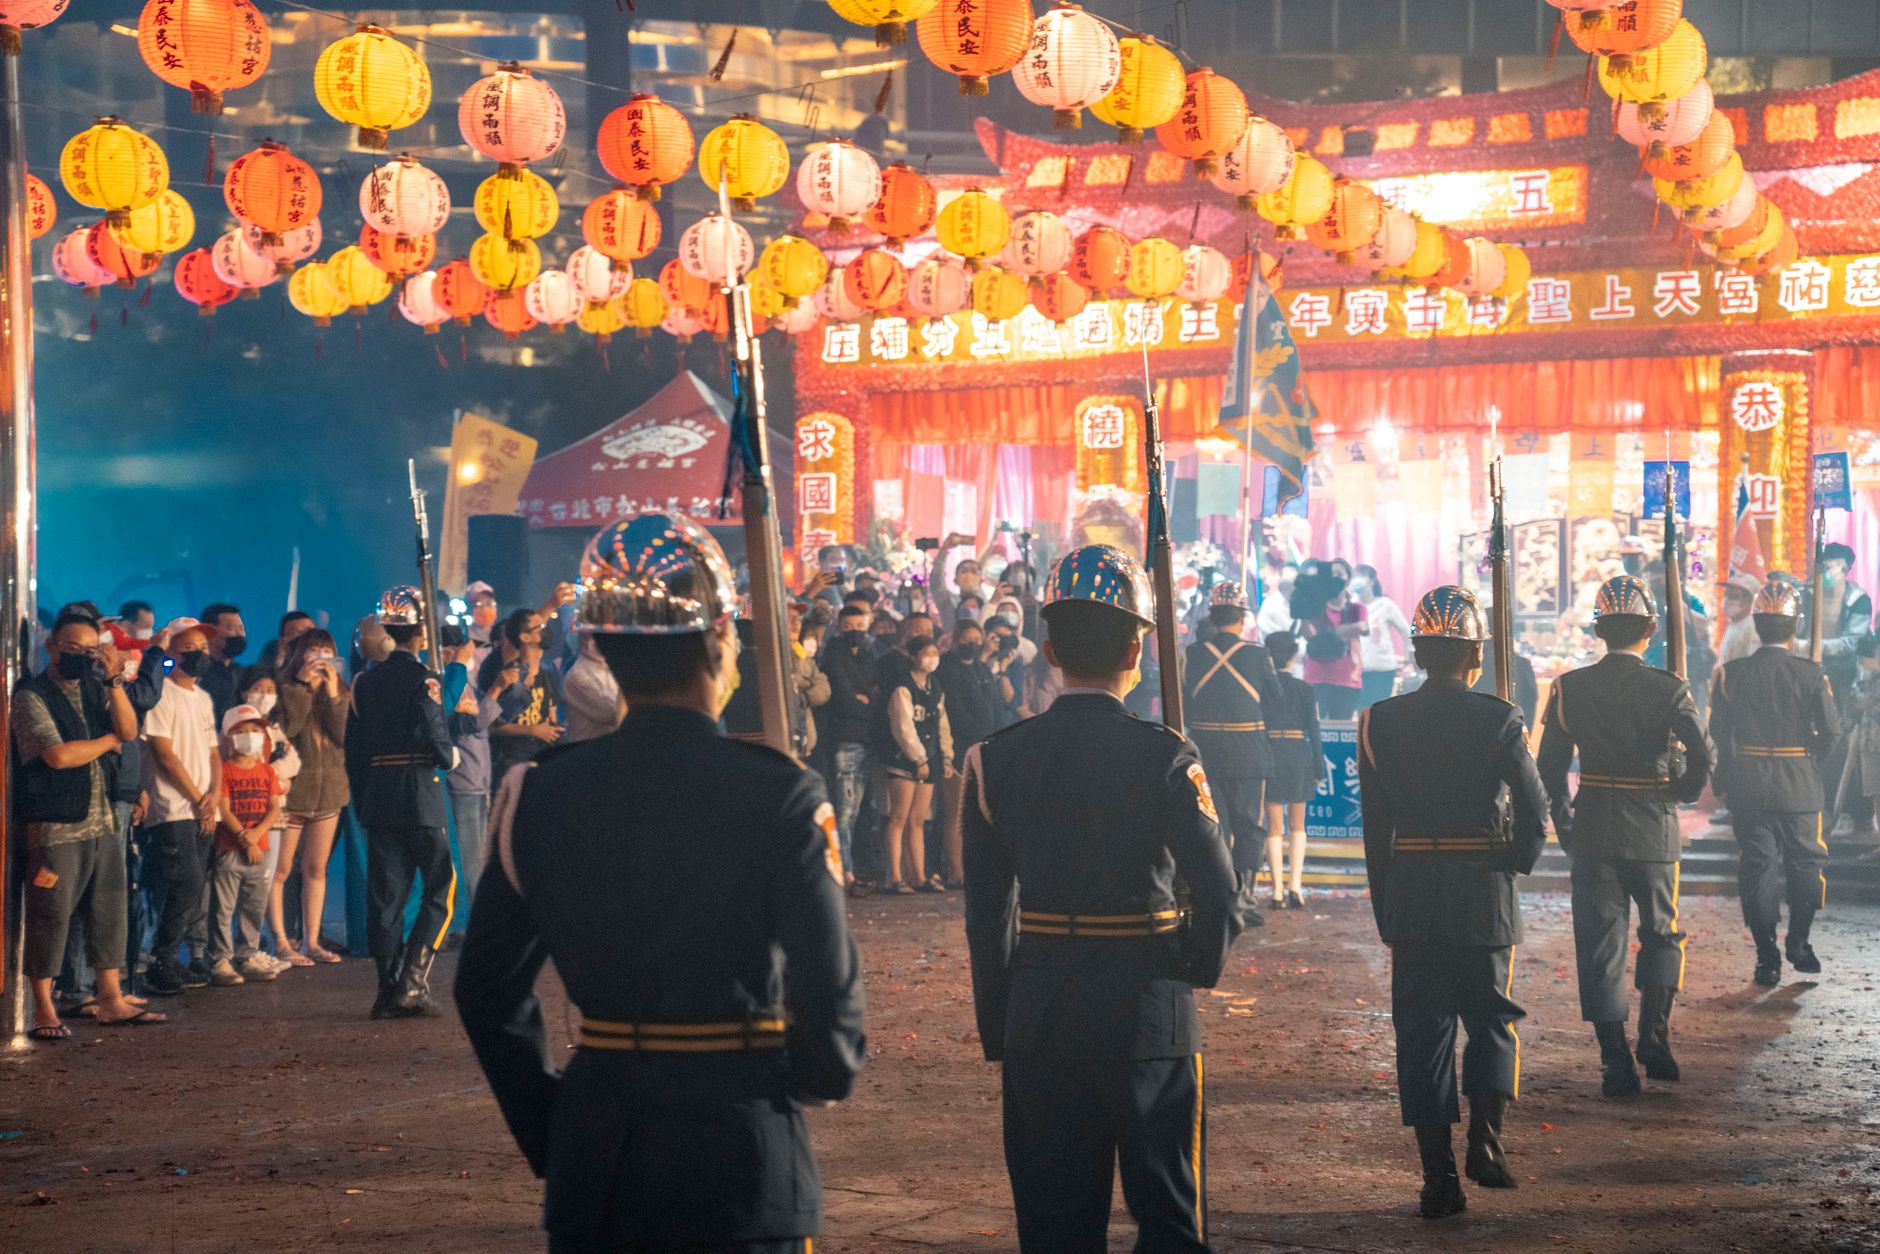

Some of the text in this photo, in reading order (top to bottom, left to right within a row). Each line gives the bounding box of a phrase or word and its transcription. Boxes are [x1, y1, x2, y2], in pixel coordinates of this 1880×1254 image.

[241, 11, 264, 76] 慈祐宮
[954, 0, 981, 56] 泰民安
[1031, 17, 1056, 89] 風調雨順
[335, 41, 361, 111] 風調雨順
[481, 79, 504, 146] 風調雨順
[626, 109, 651, 171] 國泰民安
[1181, 81, 1203, 141] 風調雨順
[71, 133, 95, 197] 風調雨順
[138, 136, 162, 199] 天上聖母
[228, 157, 250, 217] 國泰民安
[817, 151, 835, 203] 風調雨順
[1223, 151, 1241, 181] 民安
[28, 185, 46, 230] 慈祐宮
[601, 197, 618, 247] 風調雨順
[1020, 219, 1037, 267] 國泰民安
